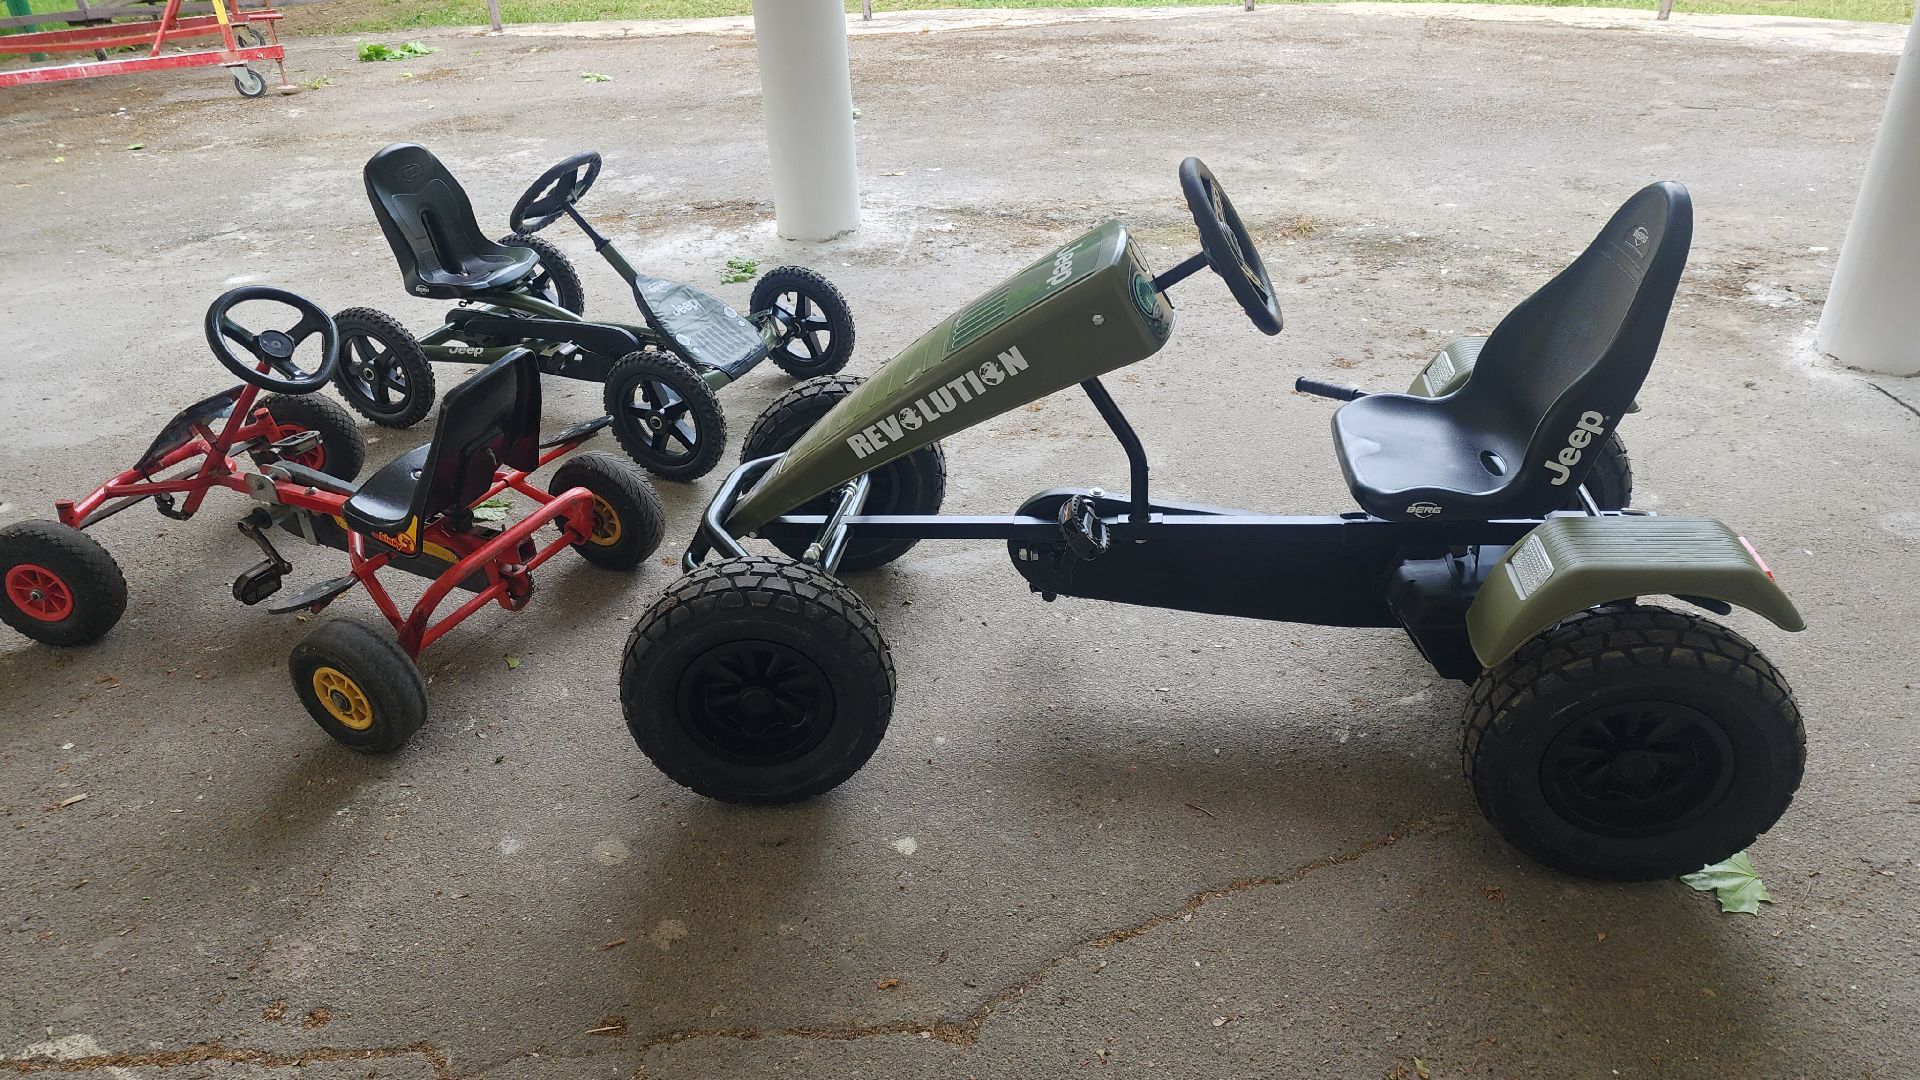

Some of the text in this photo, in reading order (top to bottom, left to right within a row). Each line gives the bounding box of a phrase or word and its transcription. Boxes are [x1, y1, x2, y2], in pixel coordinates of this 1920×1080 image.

[1045, 242, 1083, 286] Jeep
[670, 299, 702, 316] Jeep
[448, 346, 484, 357] Jeep
[846, 345, 1030, 460] REVOLUTION
[1543, 410, 1605, 486] Jeep
[1406, 506, 1443, 514] BERG
